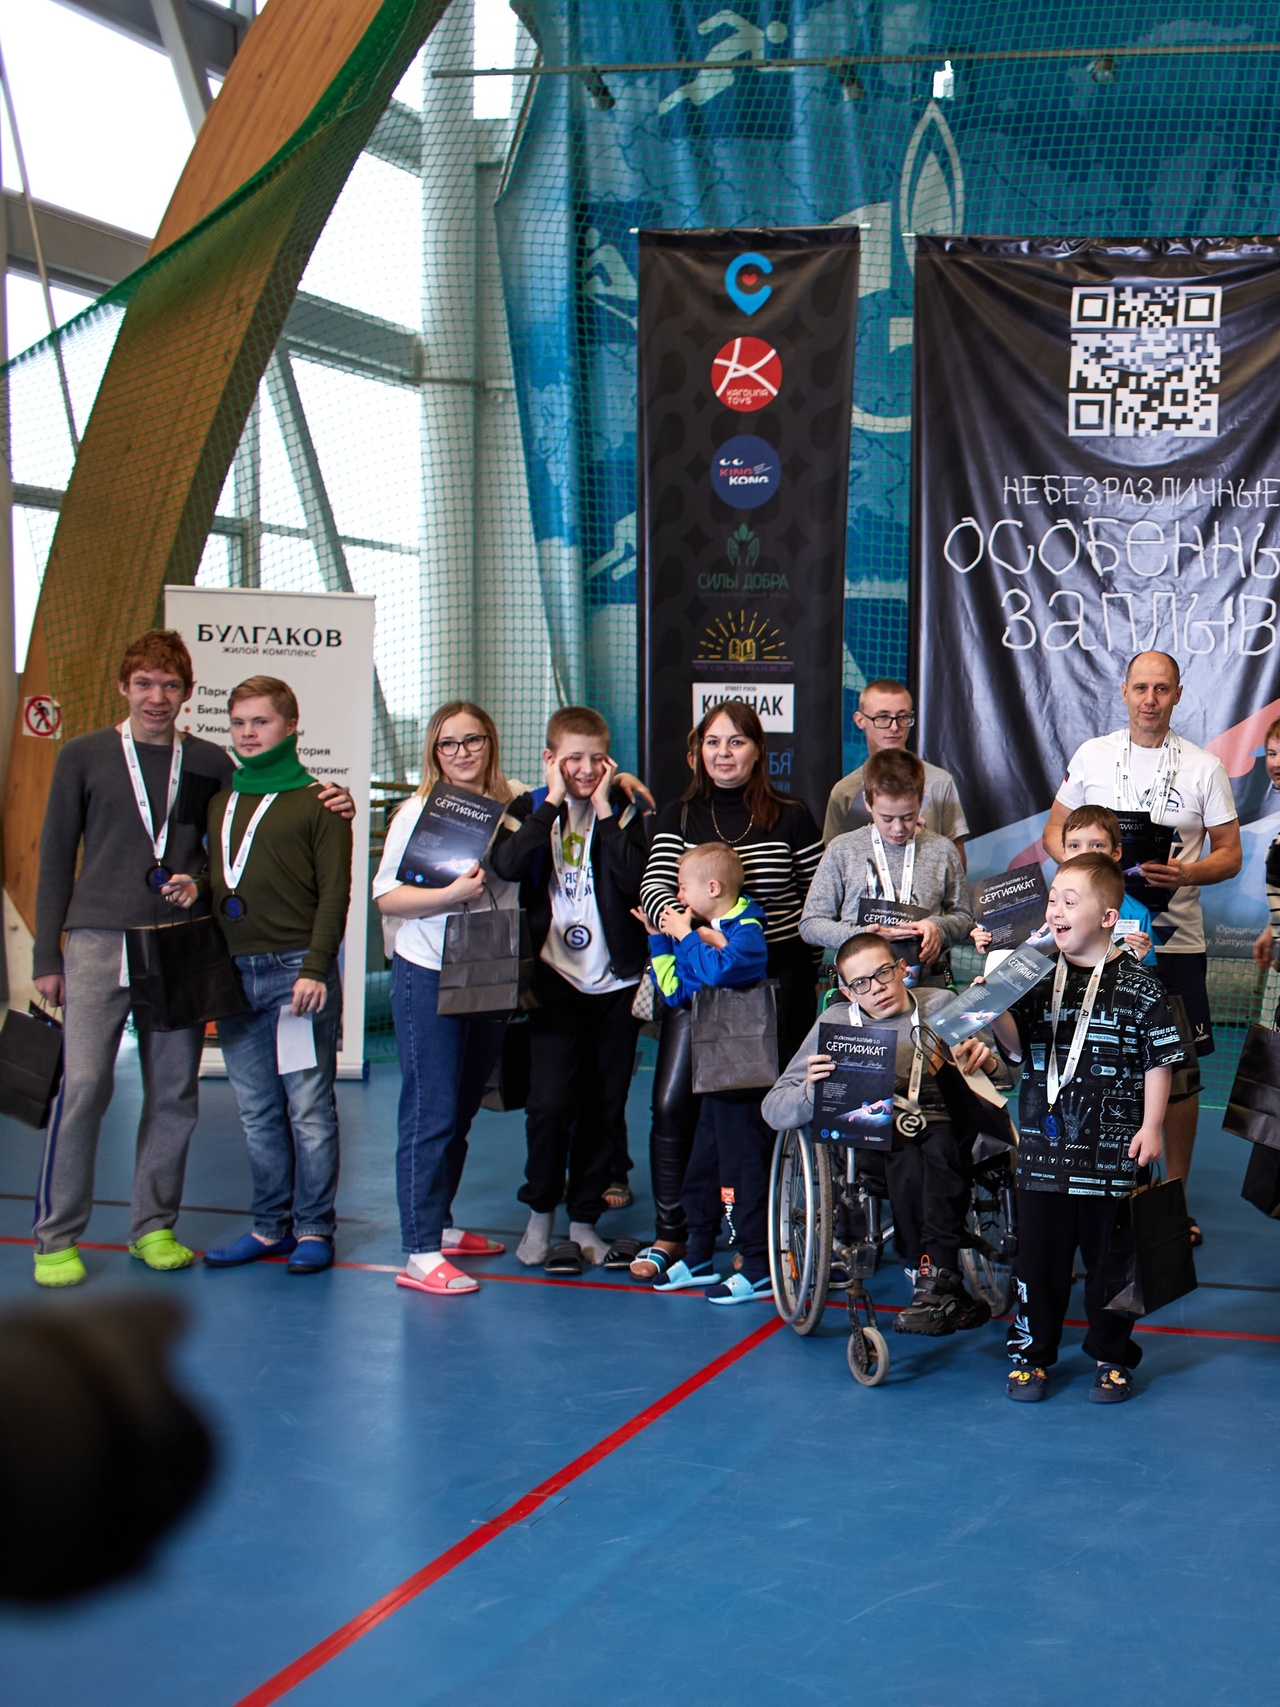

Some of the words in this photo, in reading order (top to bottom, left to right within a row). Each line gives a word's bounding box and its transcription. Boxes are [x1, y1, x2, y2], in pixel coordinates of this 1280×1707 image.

[697, 573, 739, 590] СИЛЫ
[743, 573, 789, 590] ДОБРА
[197, 624, 342, 647] БУЛГАКОВ
[198, 687, 228, 698] Парк
[298, 748, 331, 757] тория
[435, 797, 492, 823] СЕРТИФИКАТ
[980, 878, 1036, 905] СЕРТИФИКАТ
[1216, 924, 1265, 936] Юридичес
[1115, 986, 1137, 995] FUTURE
[826, 1041, 888, 1056] СЕРТИФИКАТ
